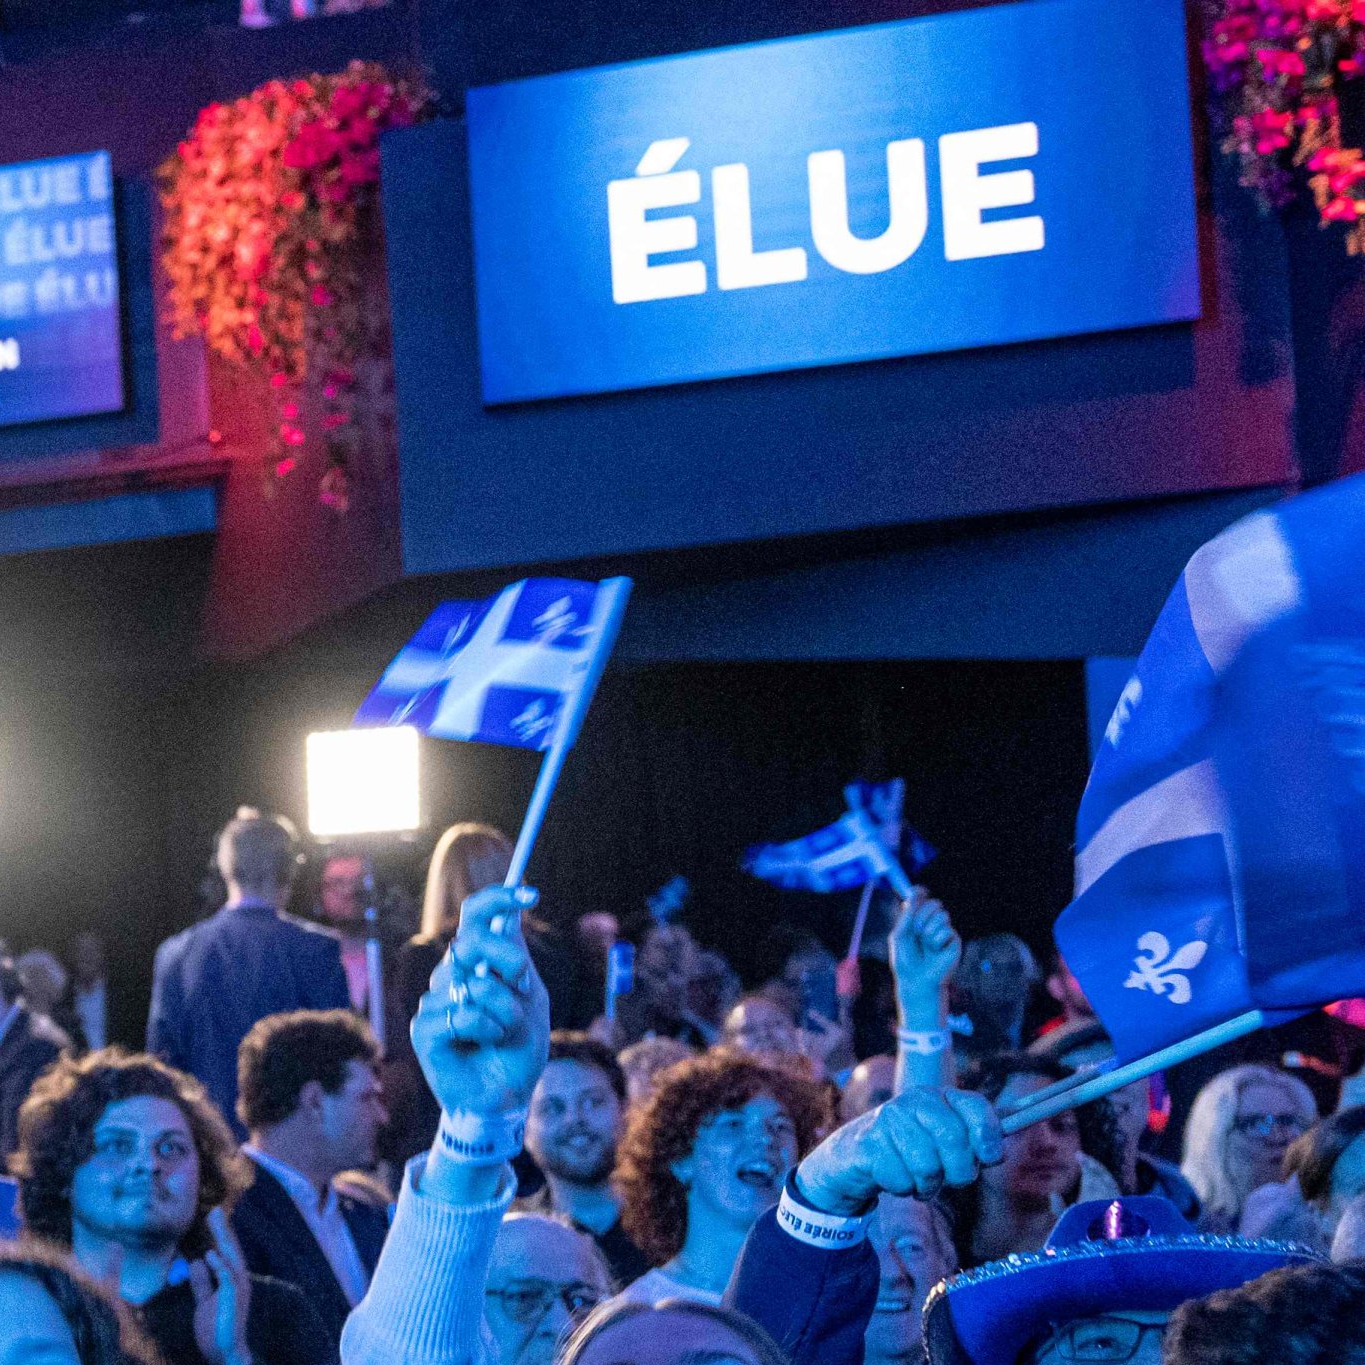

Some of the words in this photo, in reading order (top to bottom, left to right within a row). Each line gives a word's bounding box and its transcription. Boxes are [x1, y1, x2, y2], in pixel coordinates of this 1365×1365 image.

[3, 212, 112, 265] ÉLUE
[606, 121, 1045, 305] ÉLUE
[803, 1221, 856, 1241] SOIRÉE
